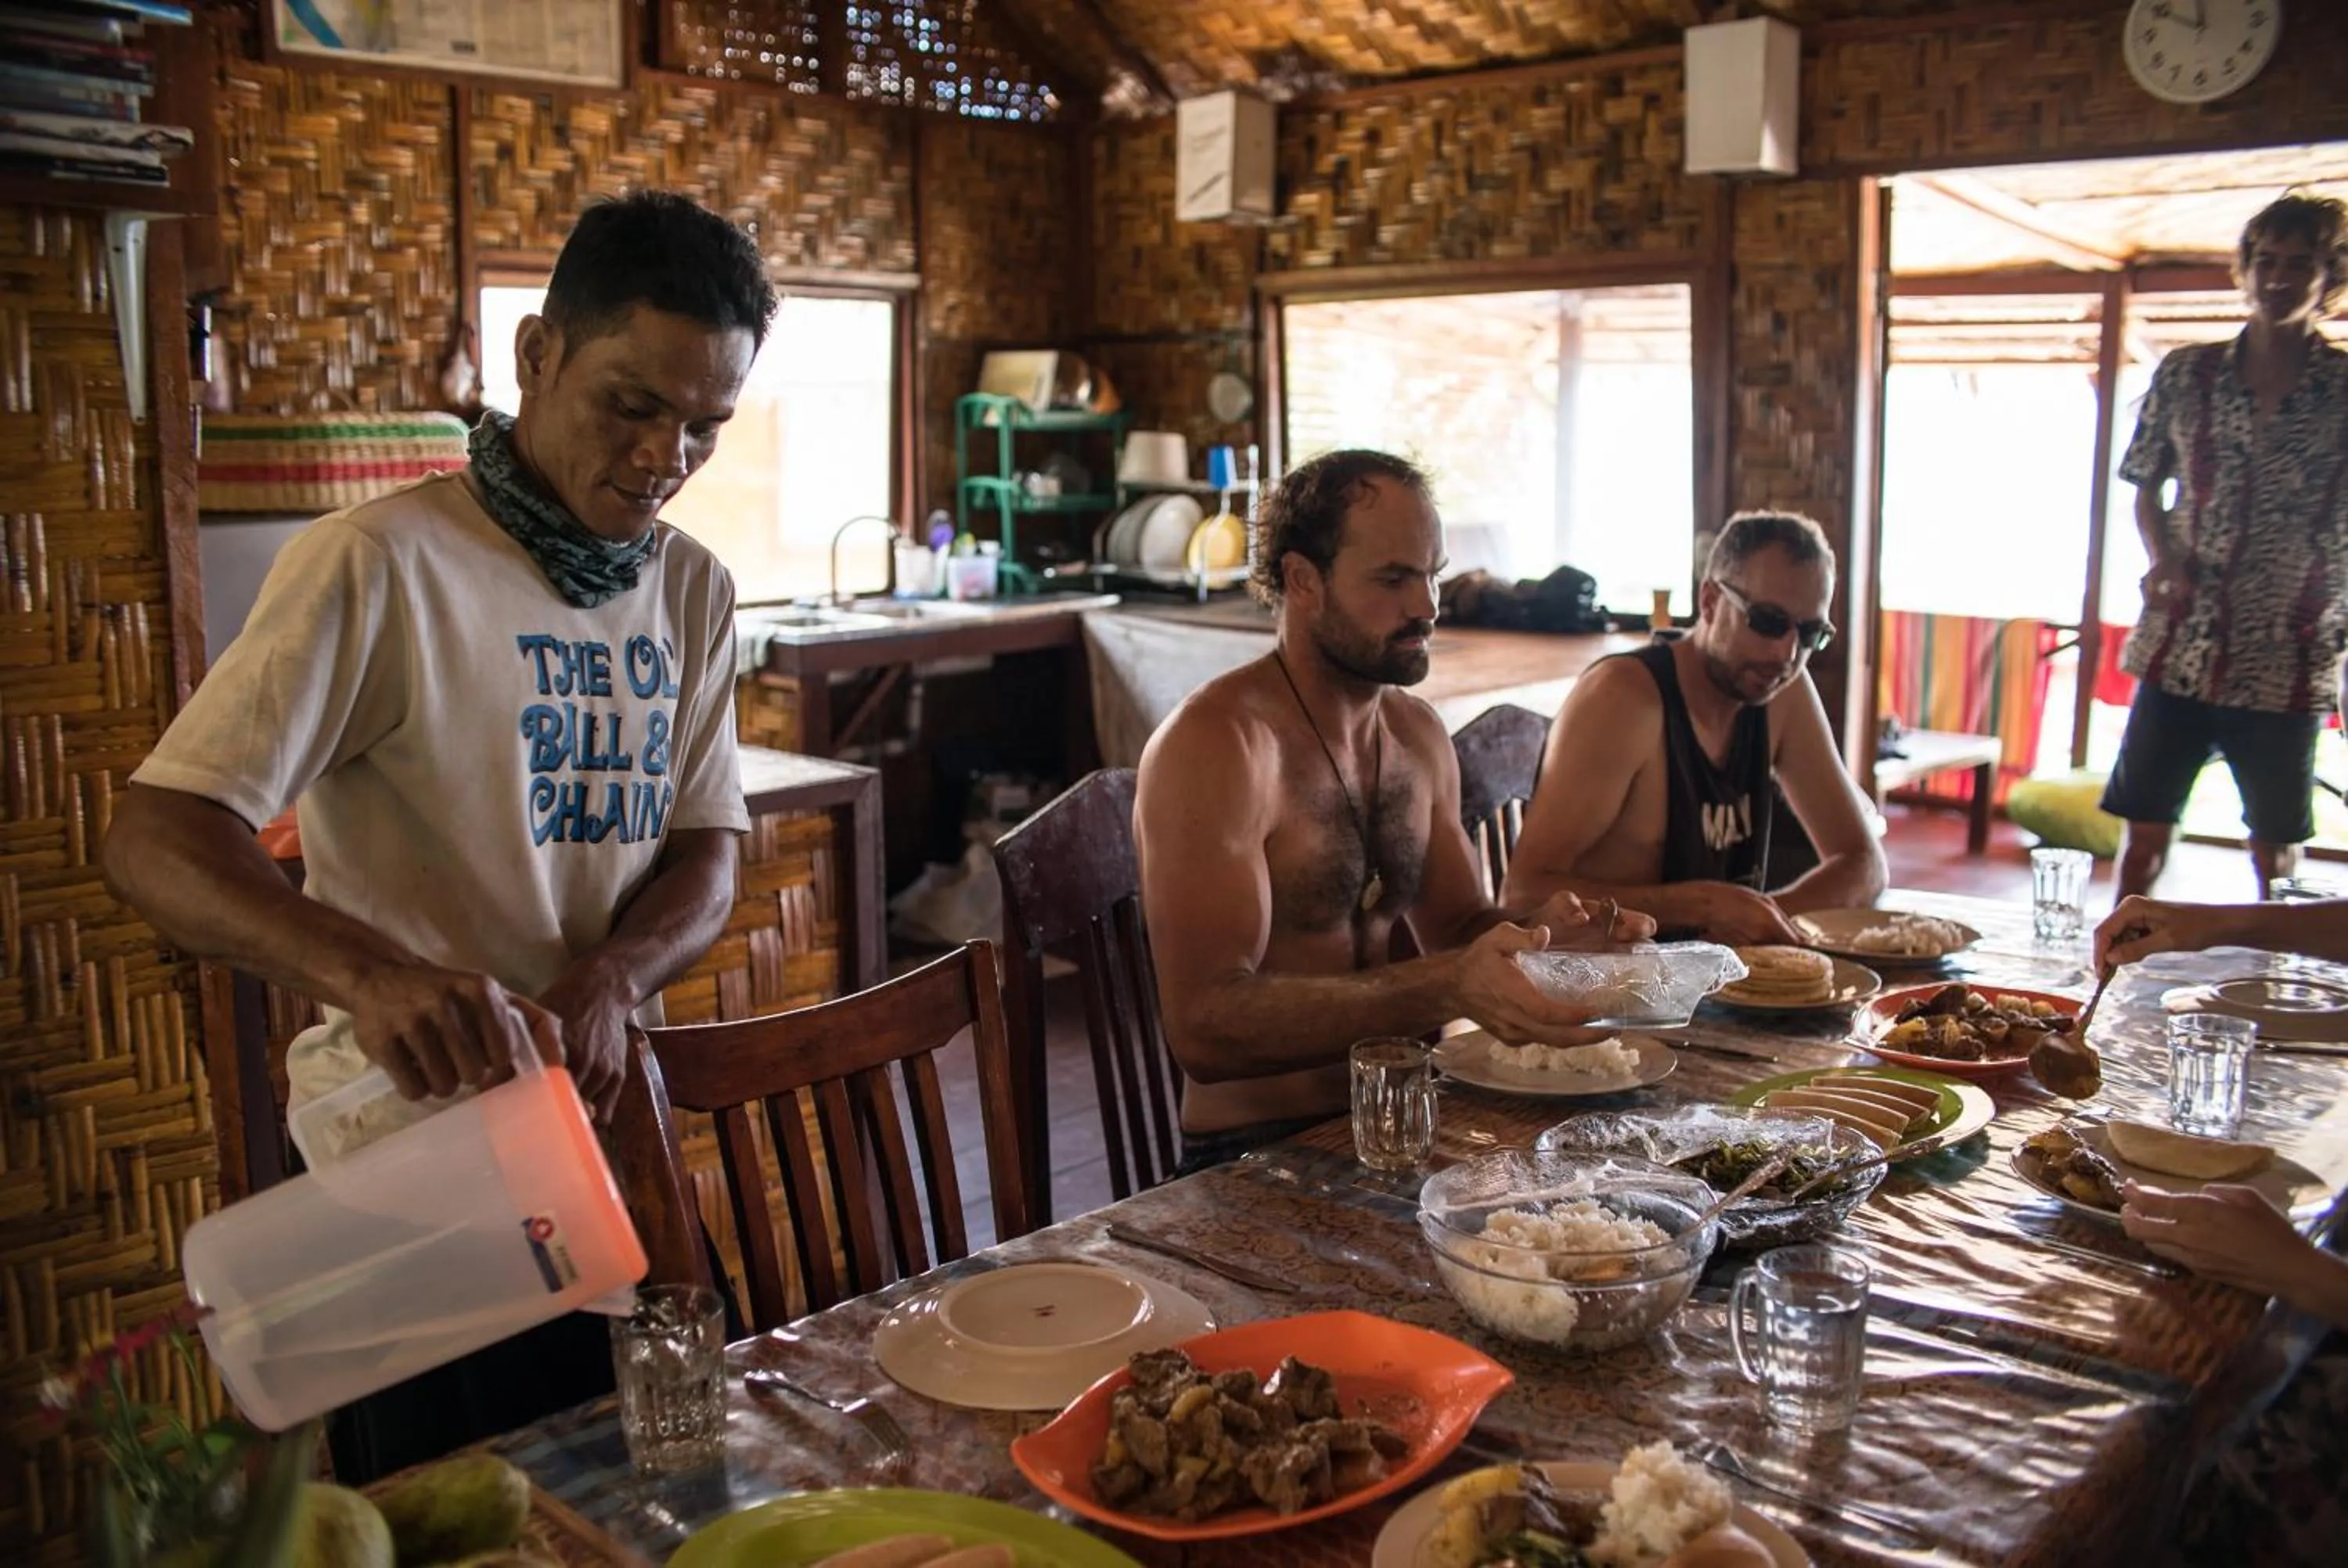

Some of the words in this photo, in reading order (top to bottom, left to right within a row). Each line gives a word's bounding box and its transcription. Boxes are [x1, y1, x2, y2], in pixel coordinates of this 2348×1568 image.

[516, 634, 612, 697] THE
[625, 634, 679, 700] OL
[520, 701, 632, 773] BALL
[641, 710, 671, 776] &
[528, 775, 673, 847] CHAIN
